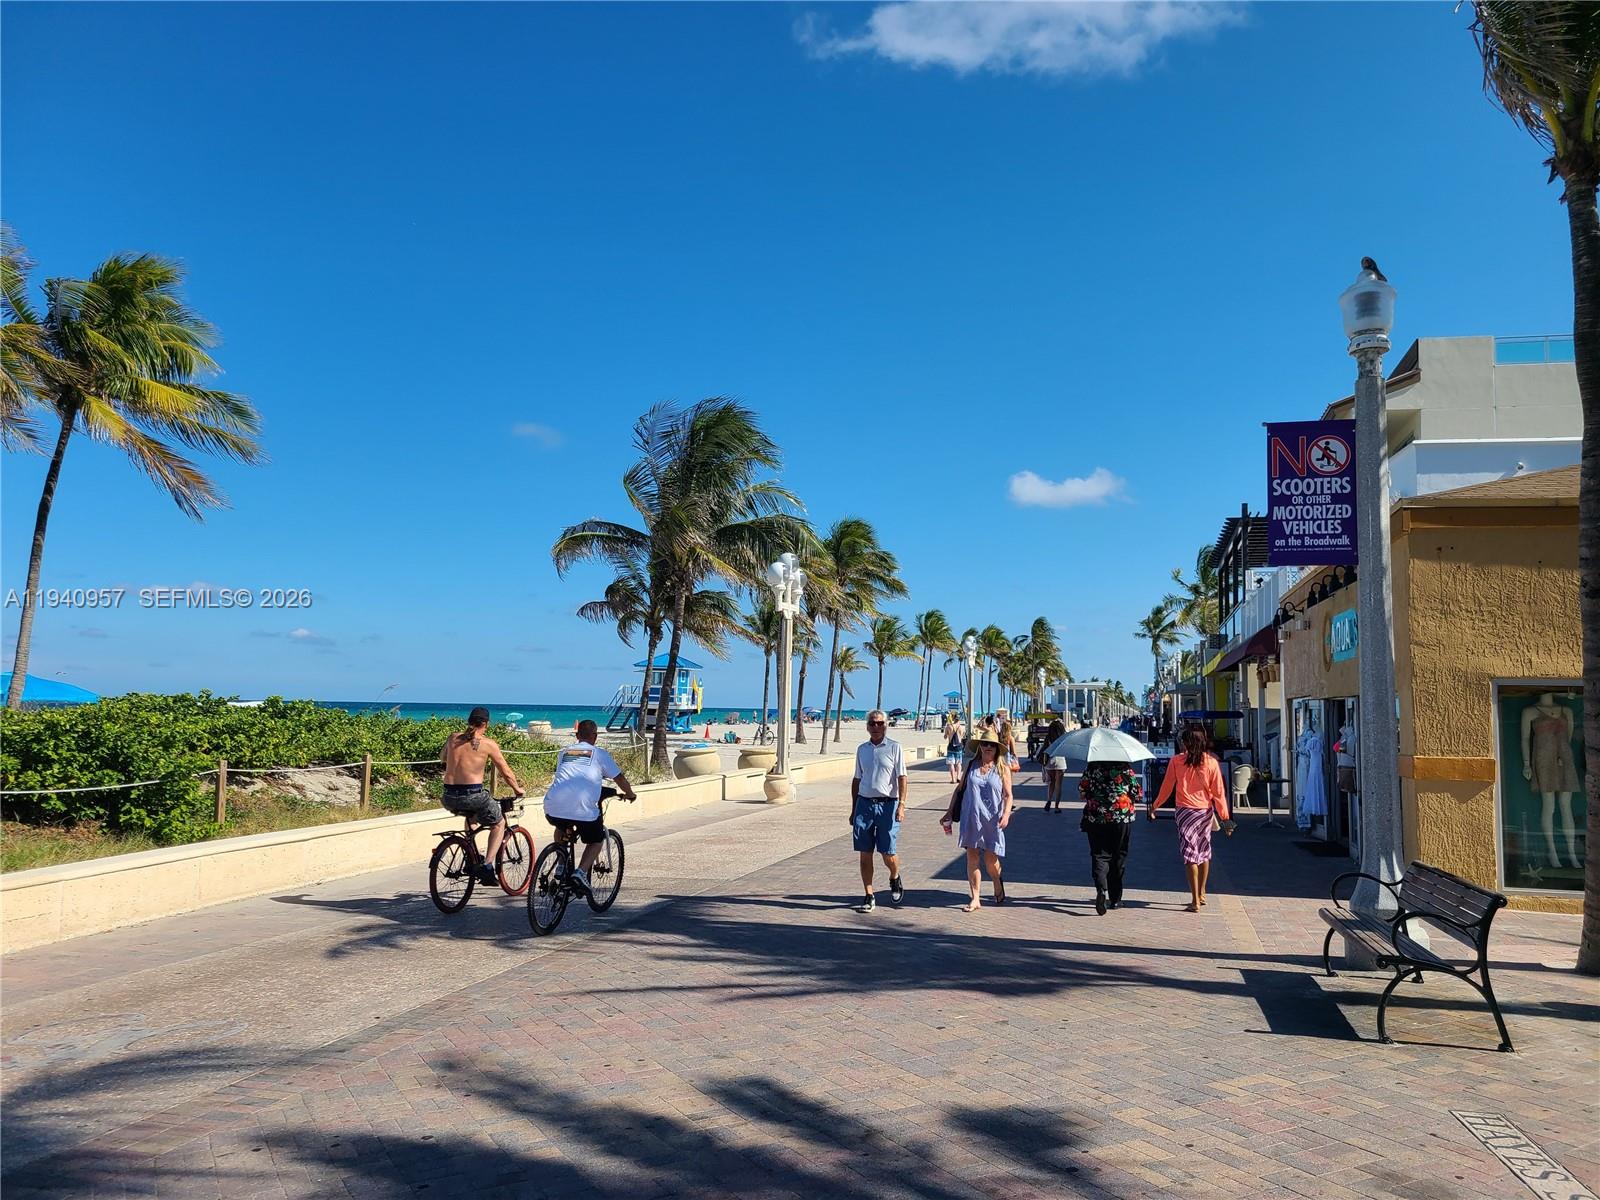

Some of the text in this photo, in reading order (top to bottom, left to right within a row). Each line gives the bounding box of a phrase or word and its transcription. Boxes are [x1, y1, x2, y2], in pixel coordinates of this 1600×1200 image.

[1272, 477, 1351, 496] SCOOTERS
[1292, 495, 1332, 505] OR OTHER
[1272, 504, 1352, 520] MOTORIZED
[1282, 519, 1342, 535] VEHICLES
[1275, 535, 1350, 546] on the Broadwalk
[1458, 1112, 1573, 1182] HAYES
